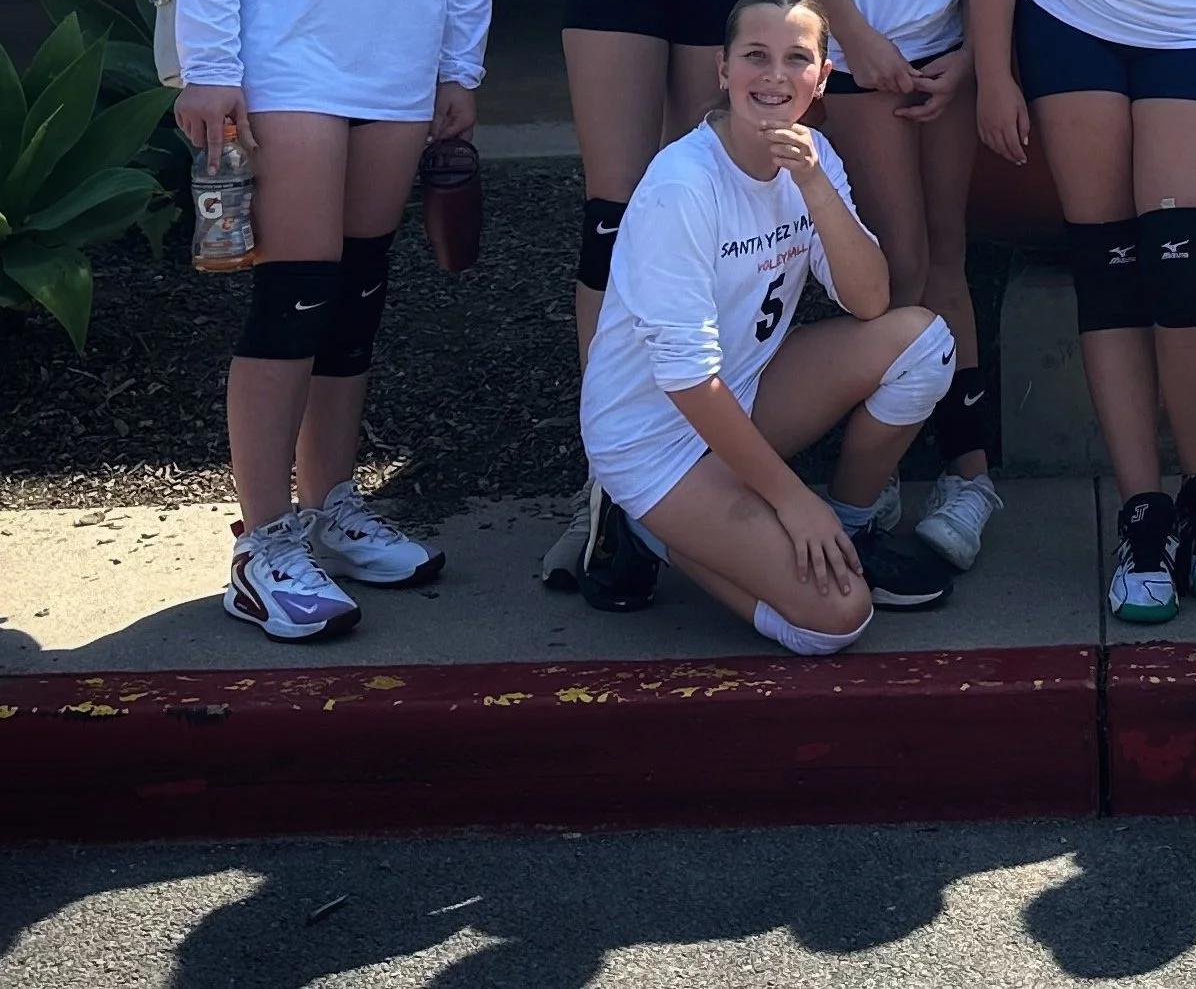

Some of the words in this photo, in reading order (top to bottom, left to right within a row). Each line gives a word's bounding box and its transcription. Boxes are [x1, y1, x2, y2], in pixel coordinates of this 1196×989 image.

[198, 191, 223, 219] G
[721, 235, 764, 258] SANTA
[793, 213, 814, 234] VAL
[755, 272, 786, 342] 5
